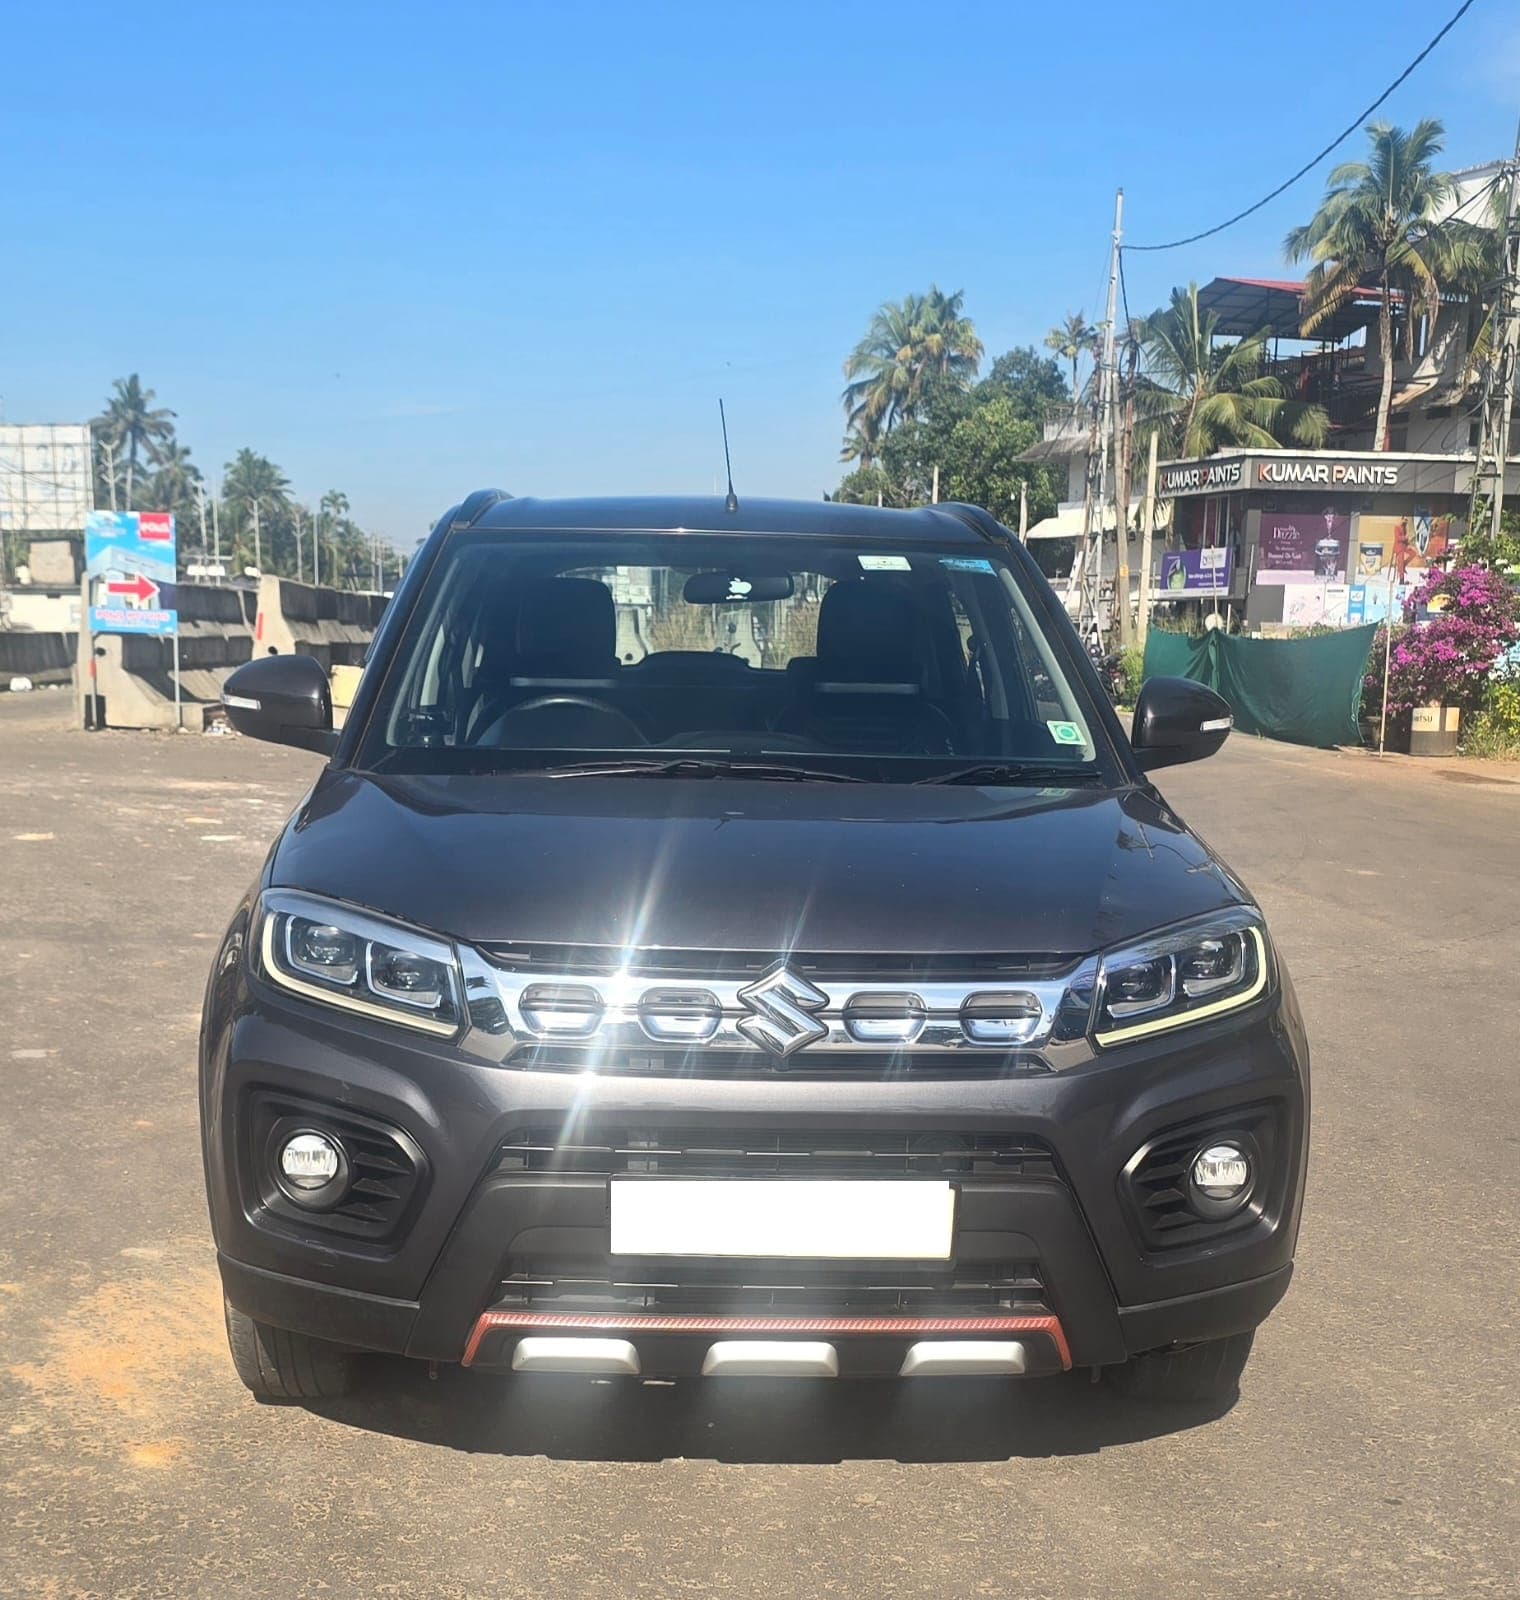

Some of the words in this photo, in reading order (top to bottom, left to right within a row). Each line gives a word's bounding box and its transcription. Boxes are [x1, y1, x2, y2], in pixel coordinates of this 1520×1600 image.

[1160, 469, 1200, 490] KUMAR
[1201, 463, 1240, 485] PAINTS
[1258, 463, 1329, 483] KUMAR
[1332, 465, 1399, 485] PAINTS
